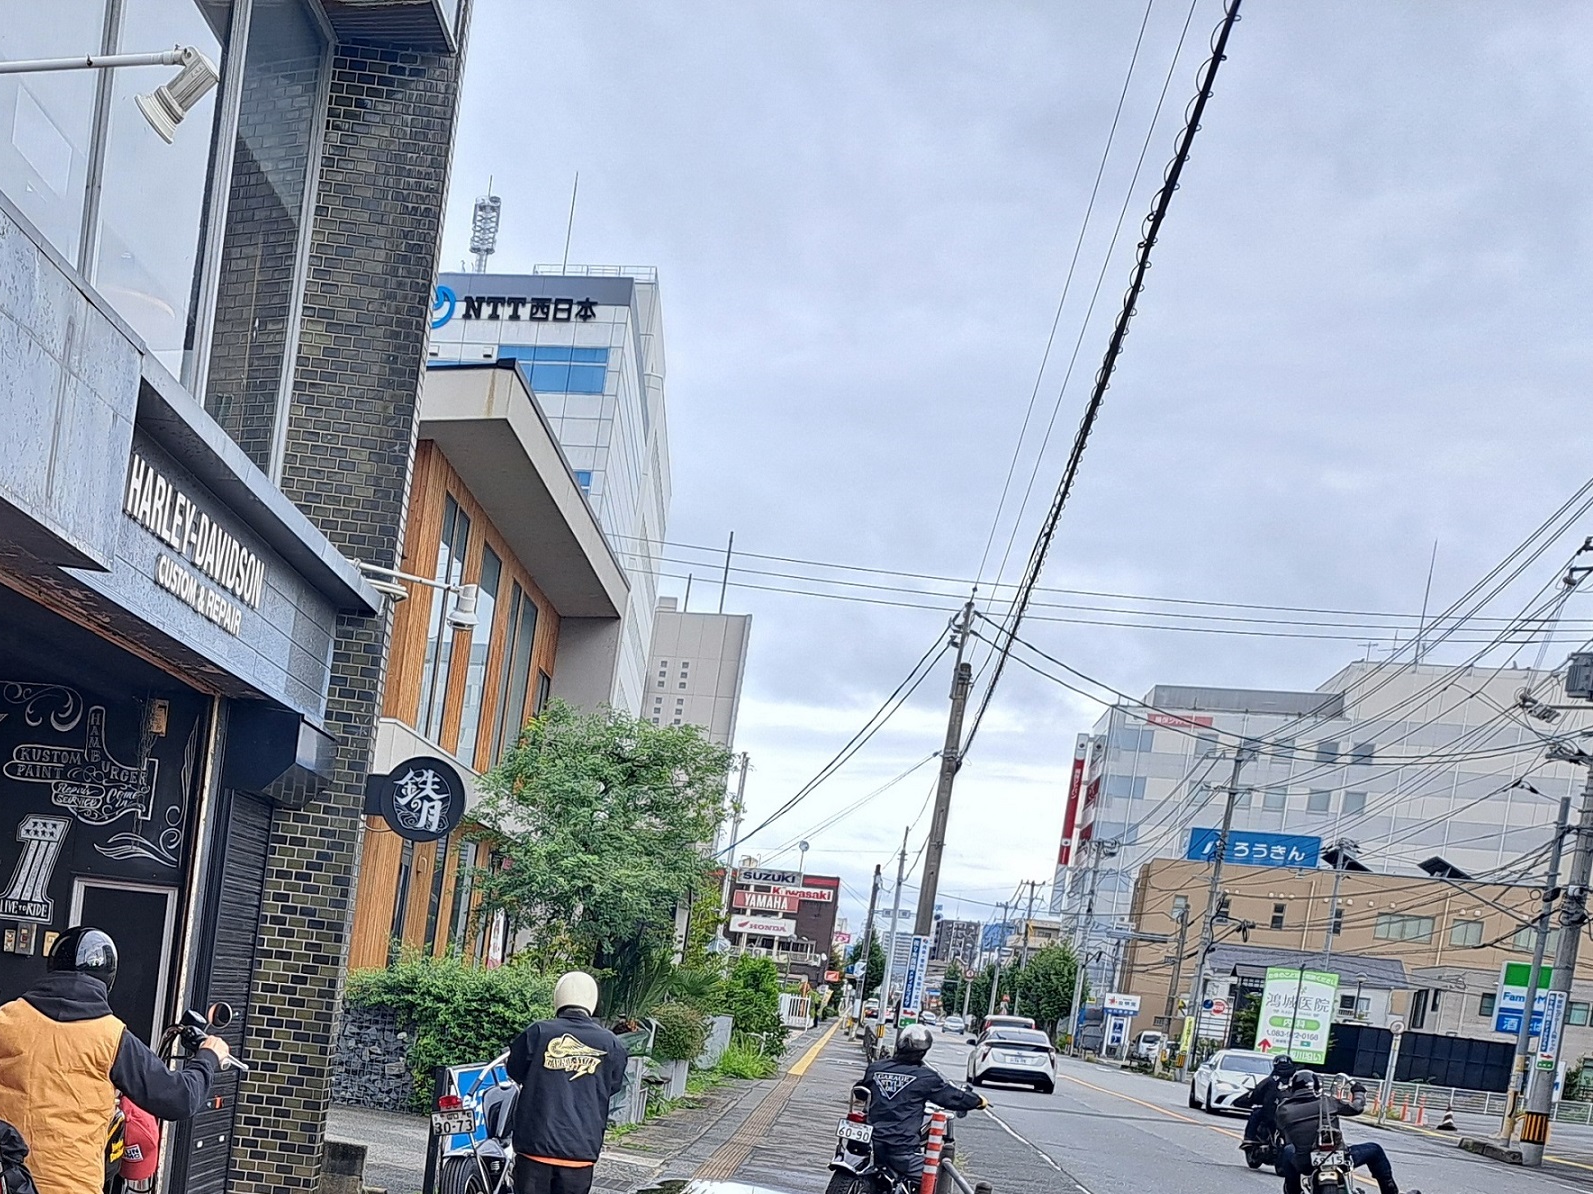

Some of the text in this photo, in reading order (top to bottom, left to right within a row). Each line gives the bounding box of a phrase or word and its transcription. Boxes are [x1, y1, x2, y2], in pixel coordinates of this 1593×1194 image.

[462, 295, 598, 322] NTT西日本
[125, 452, 266, 610] HARLEY-DAVIDSON
[157, 553, 242, 638] CUSTOM & REPAIR
[20, 747, 82, 765] KUSTOM
[16, 763, 64, 779] PAINT
[1233, 841, 1306, 862] ろうきん
[743, 871, 796, 883] SUZUKI
[744, 892, 788, 910] YAMAHA
[772, 886, 831, 900] Kwasaki
[0, 899, 19, 915] LIVE
[26, 901, 49, 918] RIDE
[749, 922, 787, 932] HONDA
[435, 1119, 474, 1135] 30-73
[838, 1126, 870, 1141] 60-90
